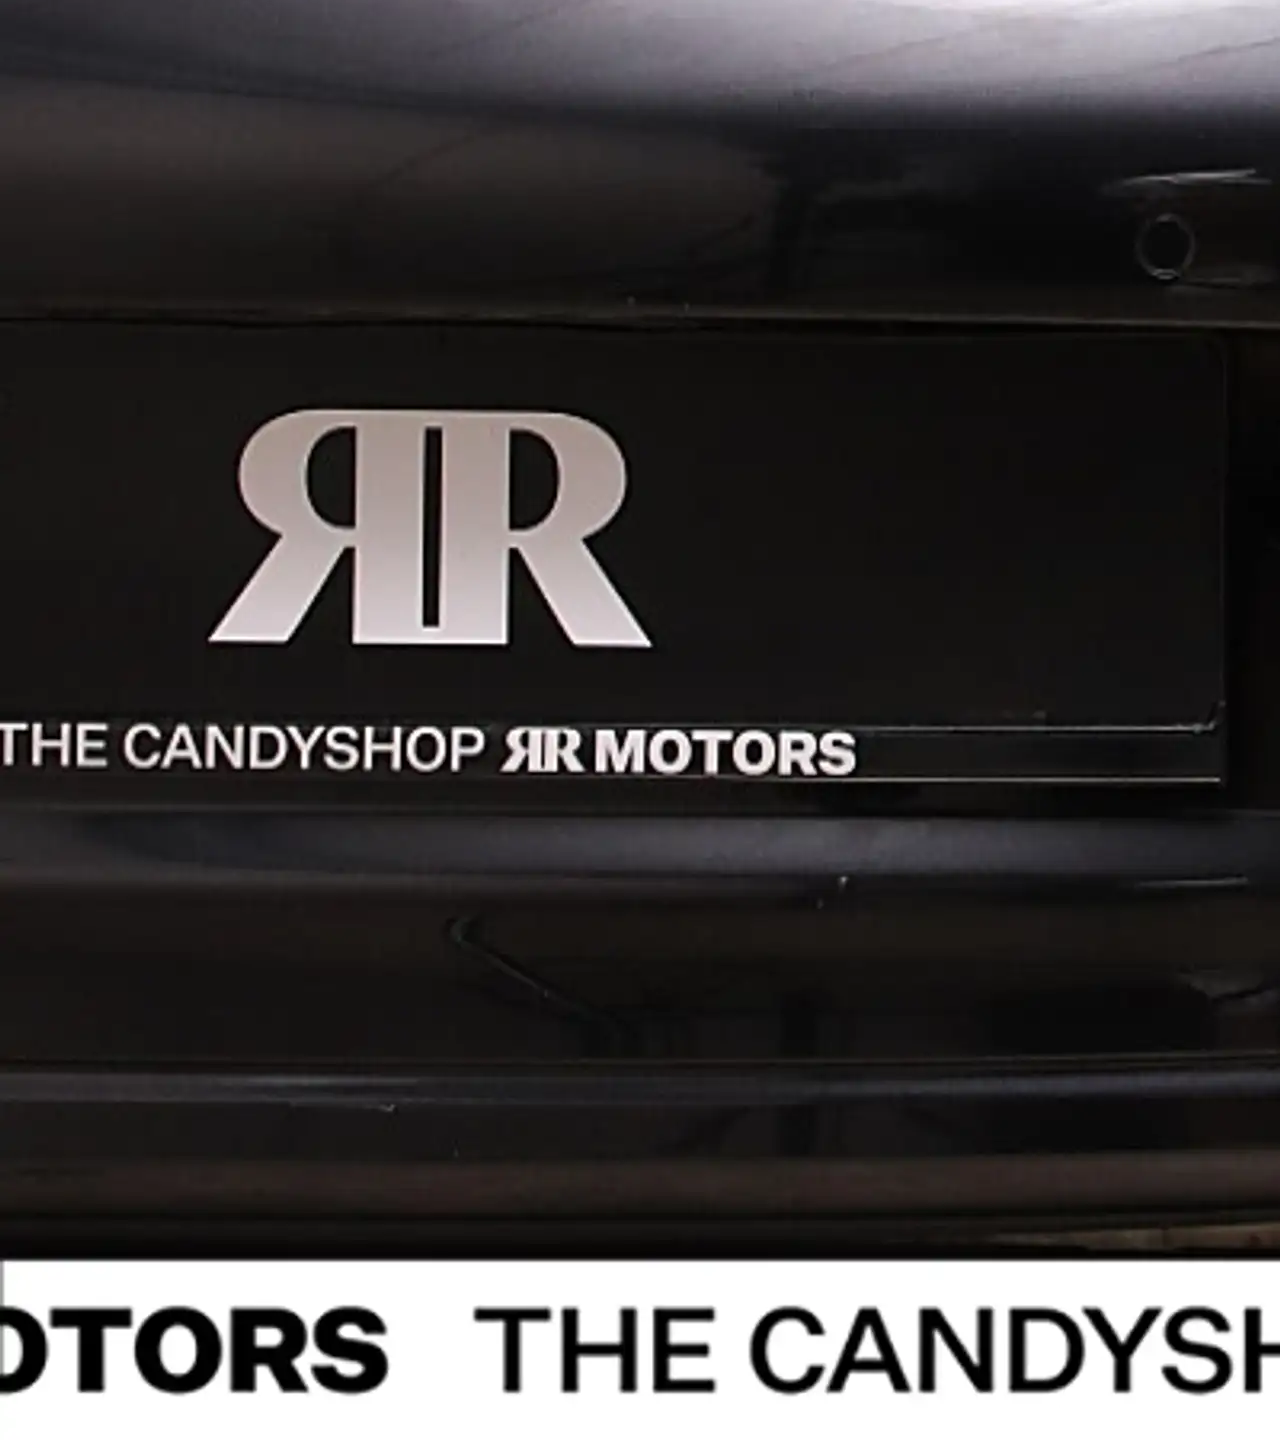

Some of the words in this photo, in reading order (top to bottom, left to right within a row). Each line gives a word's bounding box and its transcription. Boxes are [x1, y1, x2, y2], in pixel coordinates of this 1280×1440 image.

[0, 722, 109, 766] THE
[123, 722, 487, 772] CANDYSHOP
[594, 728, 858, 777] MOTORS
